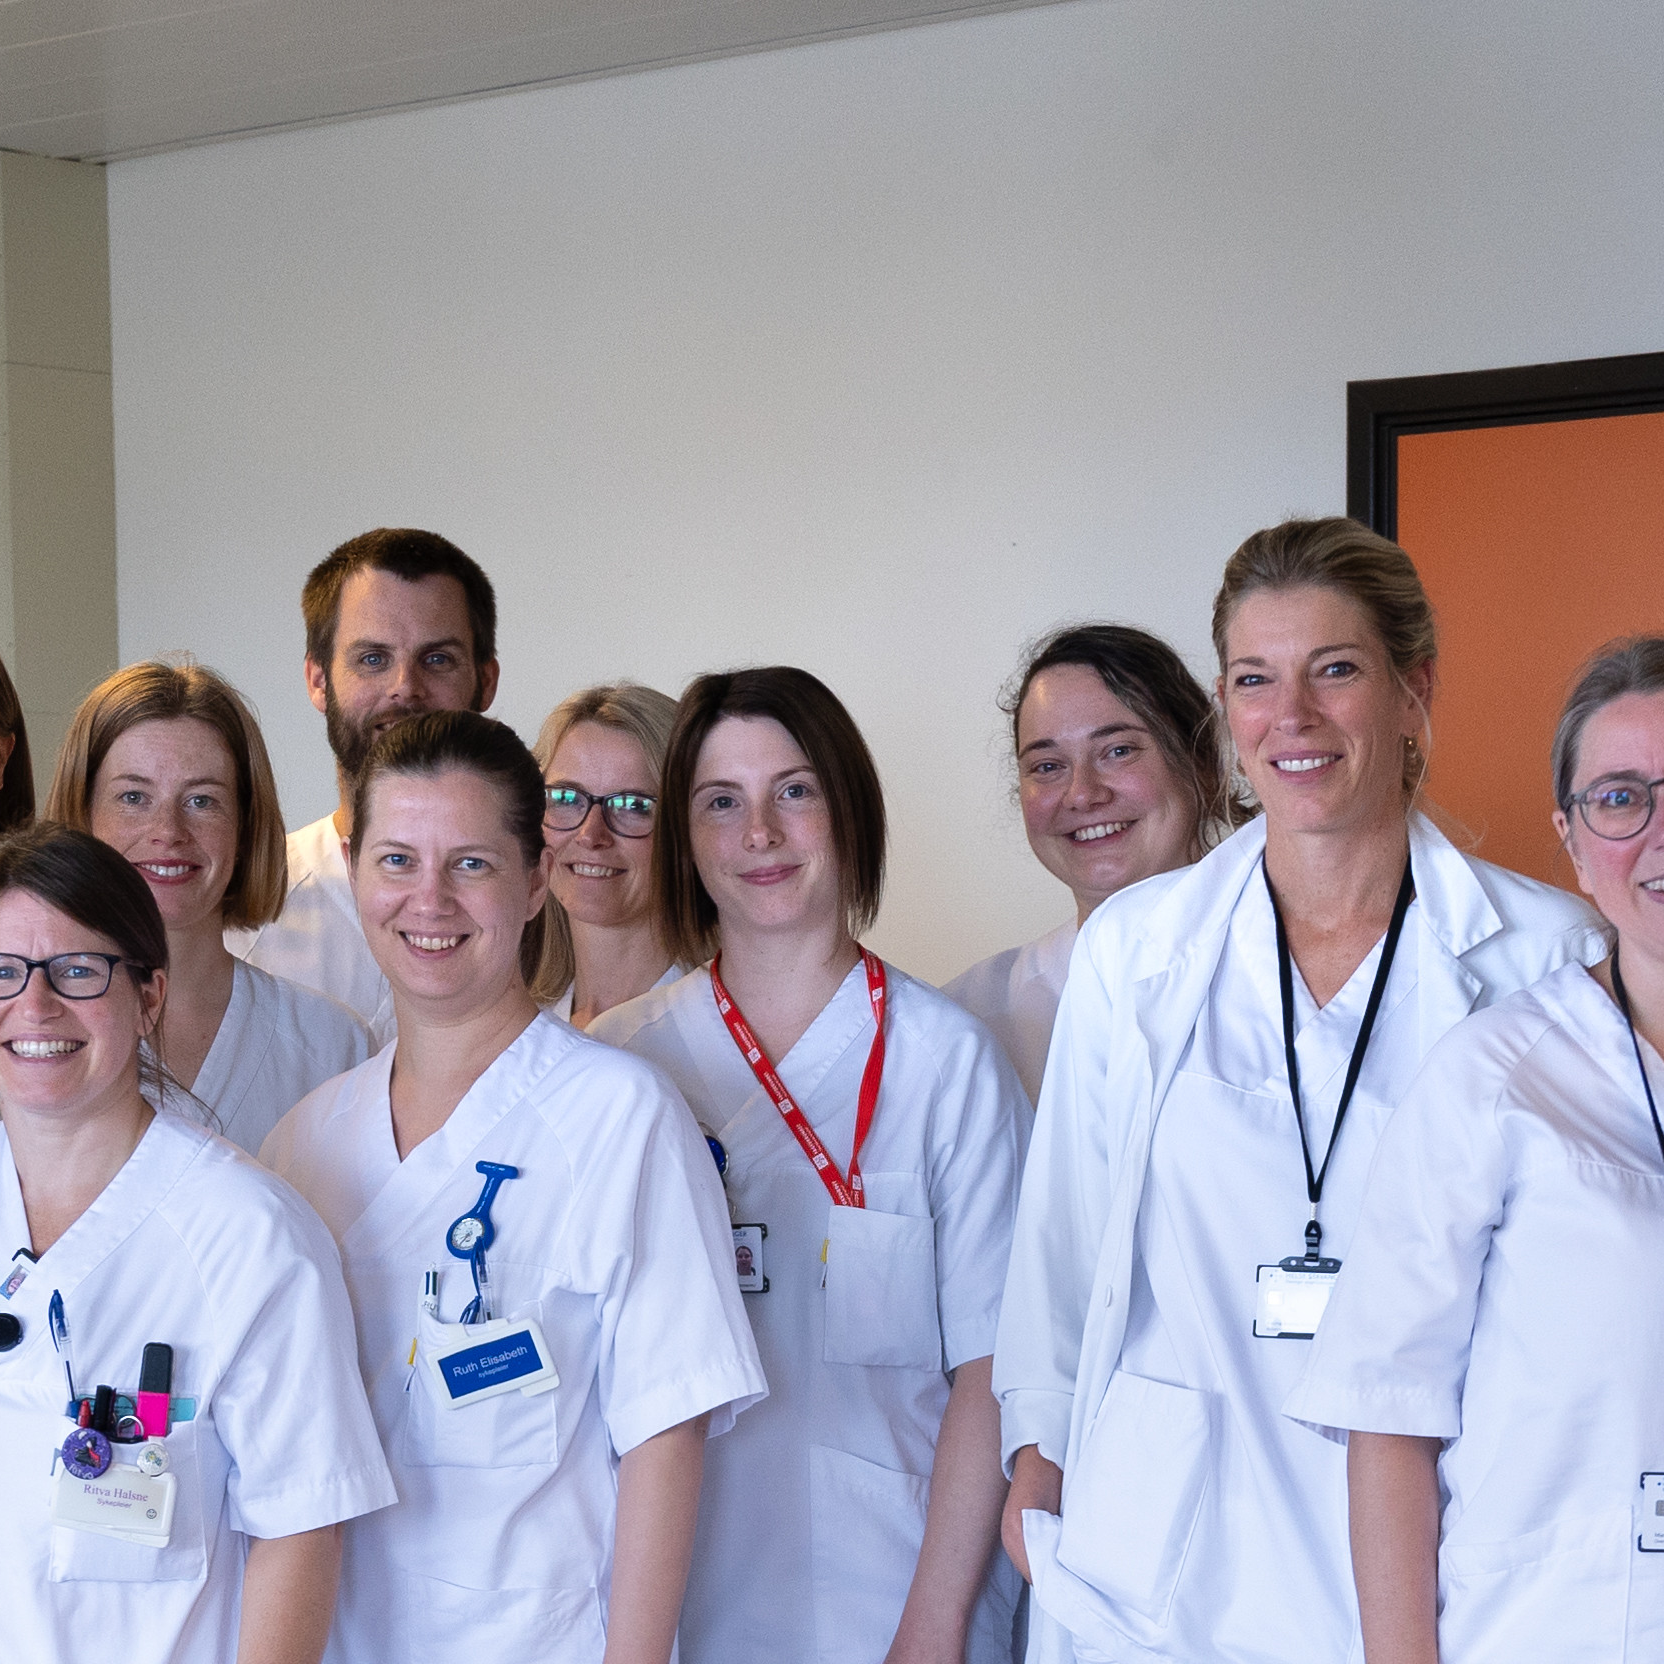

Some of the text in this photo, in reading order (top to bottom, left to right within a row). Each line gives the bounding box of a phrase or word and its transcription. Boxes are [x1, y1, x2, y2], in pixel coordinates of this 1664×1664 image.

[453, 1345, 528, 1377] Ruth Elisabeth
[83, 1483, 149, 1502] Ritva Halsne
